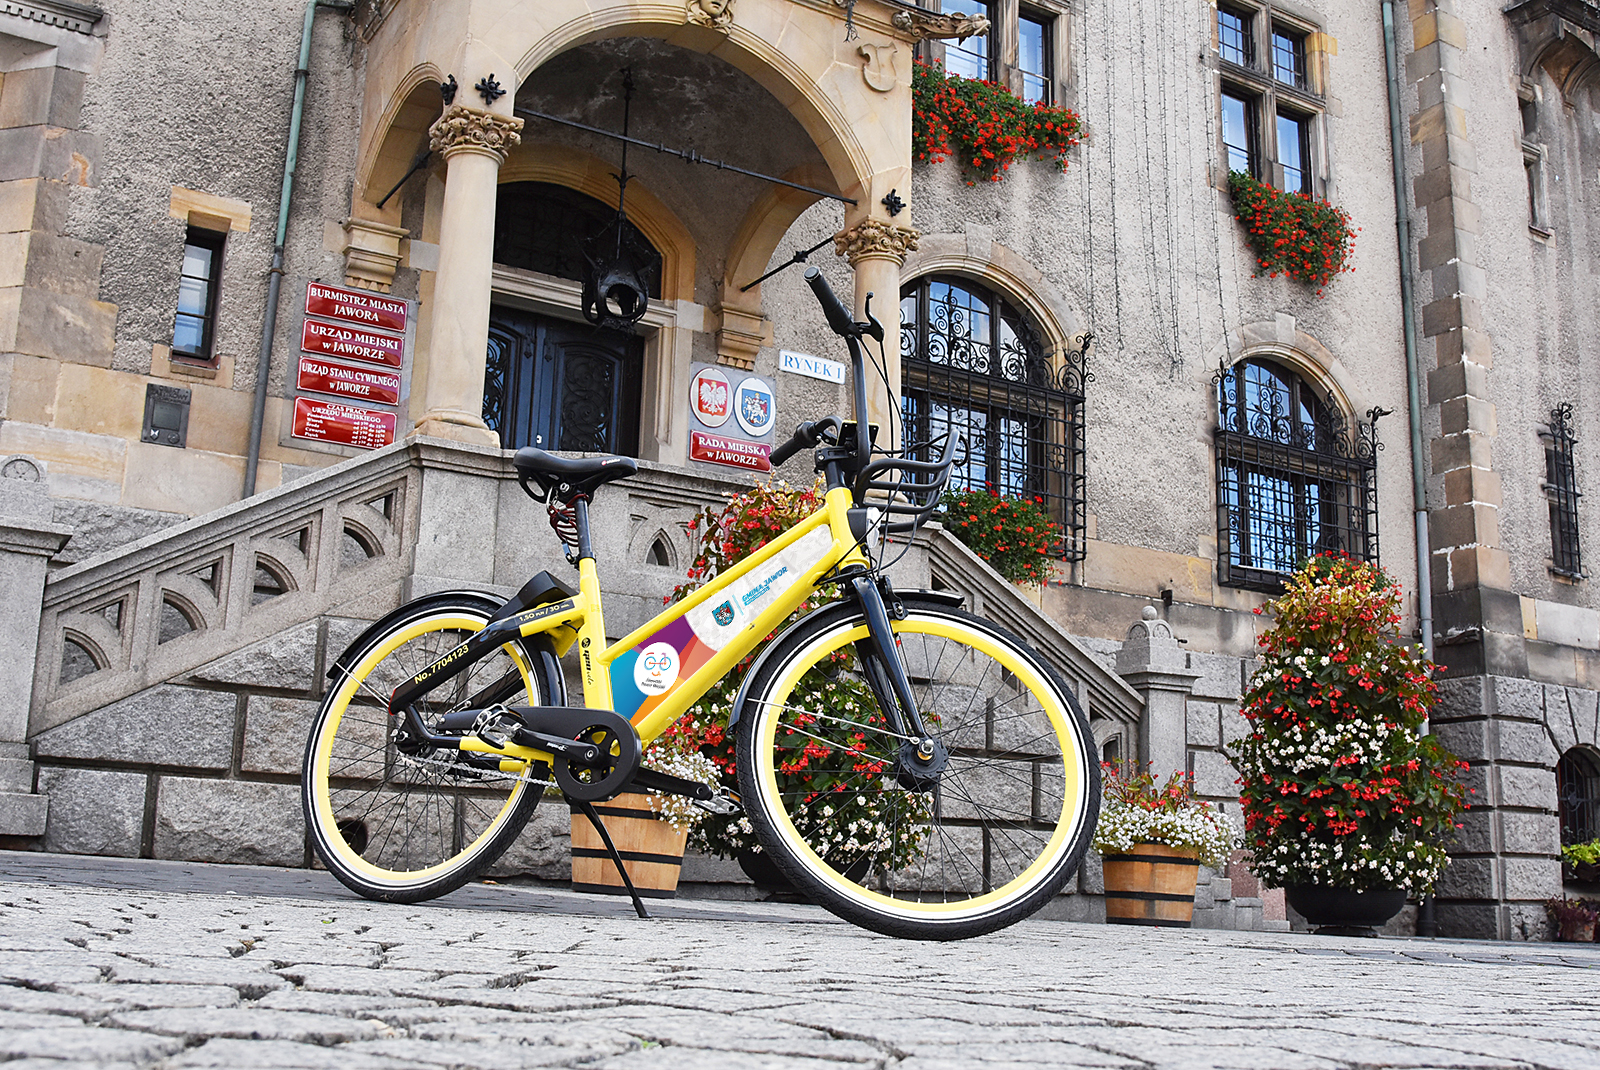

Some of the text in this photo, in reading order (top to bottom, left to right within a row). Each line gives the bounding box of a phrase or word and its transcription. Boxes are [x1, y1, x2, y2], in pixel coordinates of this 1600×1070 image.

[310, 288, 404, 314] BURMISTRZ MIASTA
[334, 305, 379, 322] JAWORA
[310, 324, 398, 350] URZĄD MIEJSKI
[333, 342, 385, 360] JAWORZE
[302, 362, 398, 388] URZĄD STANU CYWILNEGO
[784, 355, 841, 379] RYNEK 1
[336, 381, 370, 395] JAWORZE
[342, 412, 381, 423] MIEJSKIEGO
[699, 436, 766, 456] RADA MIEJSKA
[715, 451, 757, 466] JAWORZE
[764, 566, 788, 587] JAWOR
[414, 644, 469, 684] No.7704123
